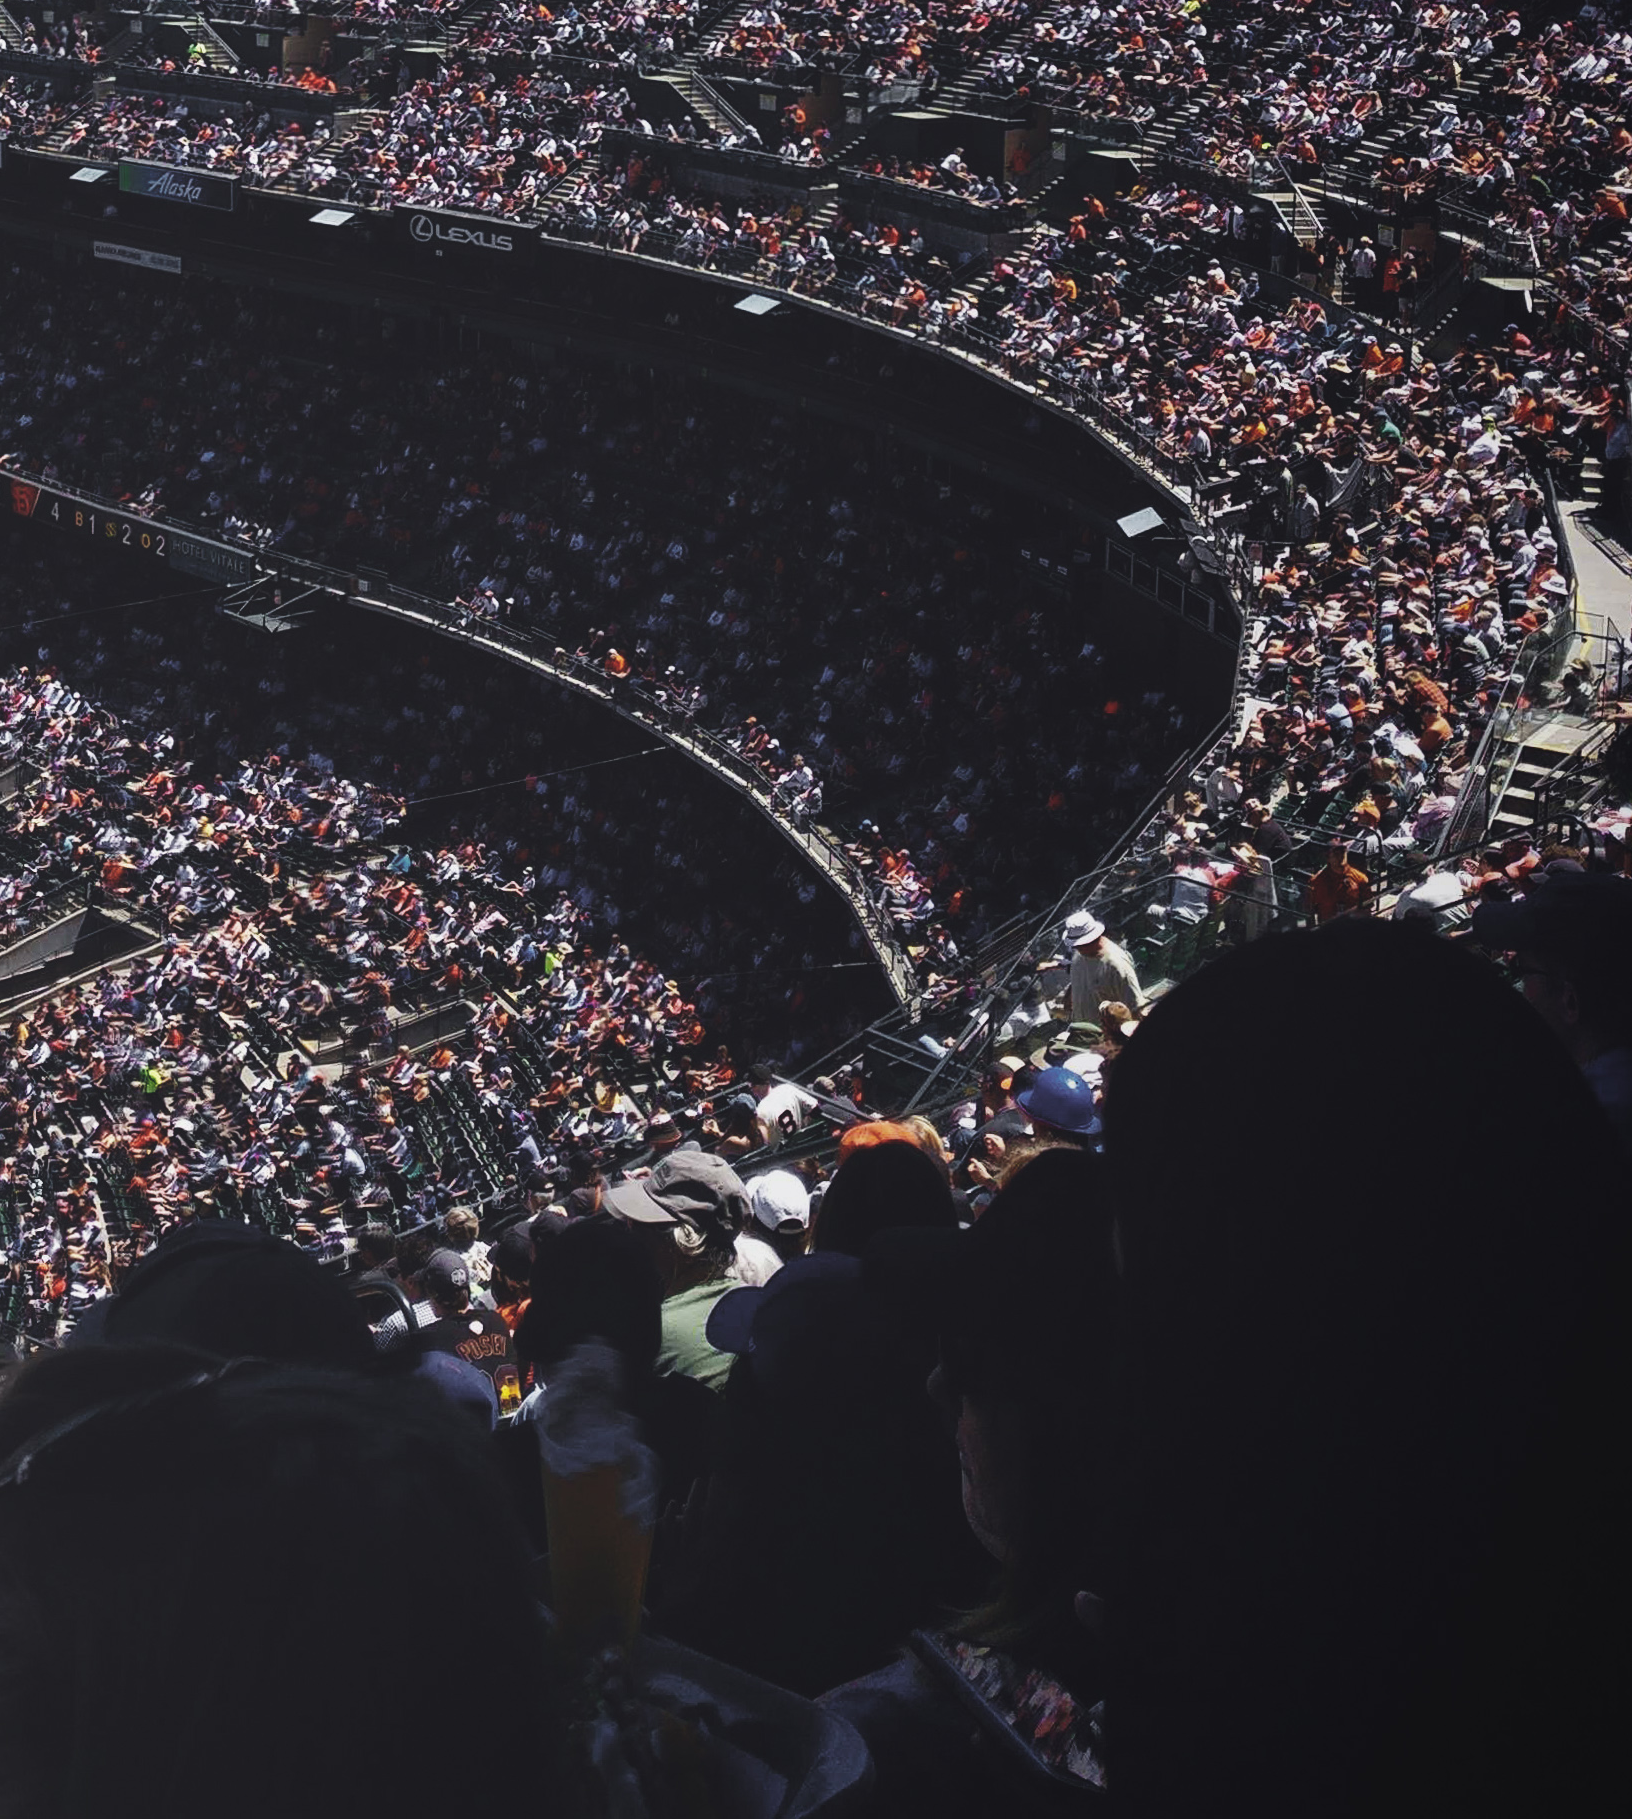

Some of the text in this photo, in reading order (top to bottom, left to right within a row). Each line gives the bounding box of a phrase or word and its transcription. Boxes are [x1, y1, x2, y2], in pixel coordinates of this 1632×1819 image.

[148, 172, 202, 202] Alaska
[435, 224, 513, 251] LEXUS
[51, 502, 59, 521] 4
[89, 514, 95, 534] 1
[122, 524, 131, 545] 2
[156, 535, 165, 556] 2
[172, 538, 208, 559] HOTEL
[209, 551, 246, 573] VITALE
[778, 1109, 798, 1139] 8
